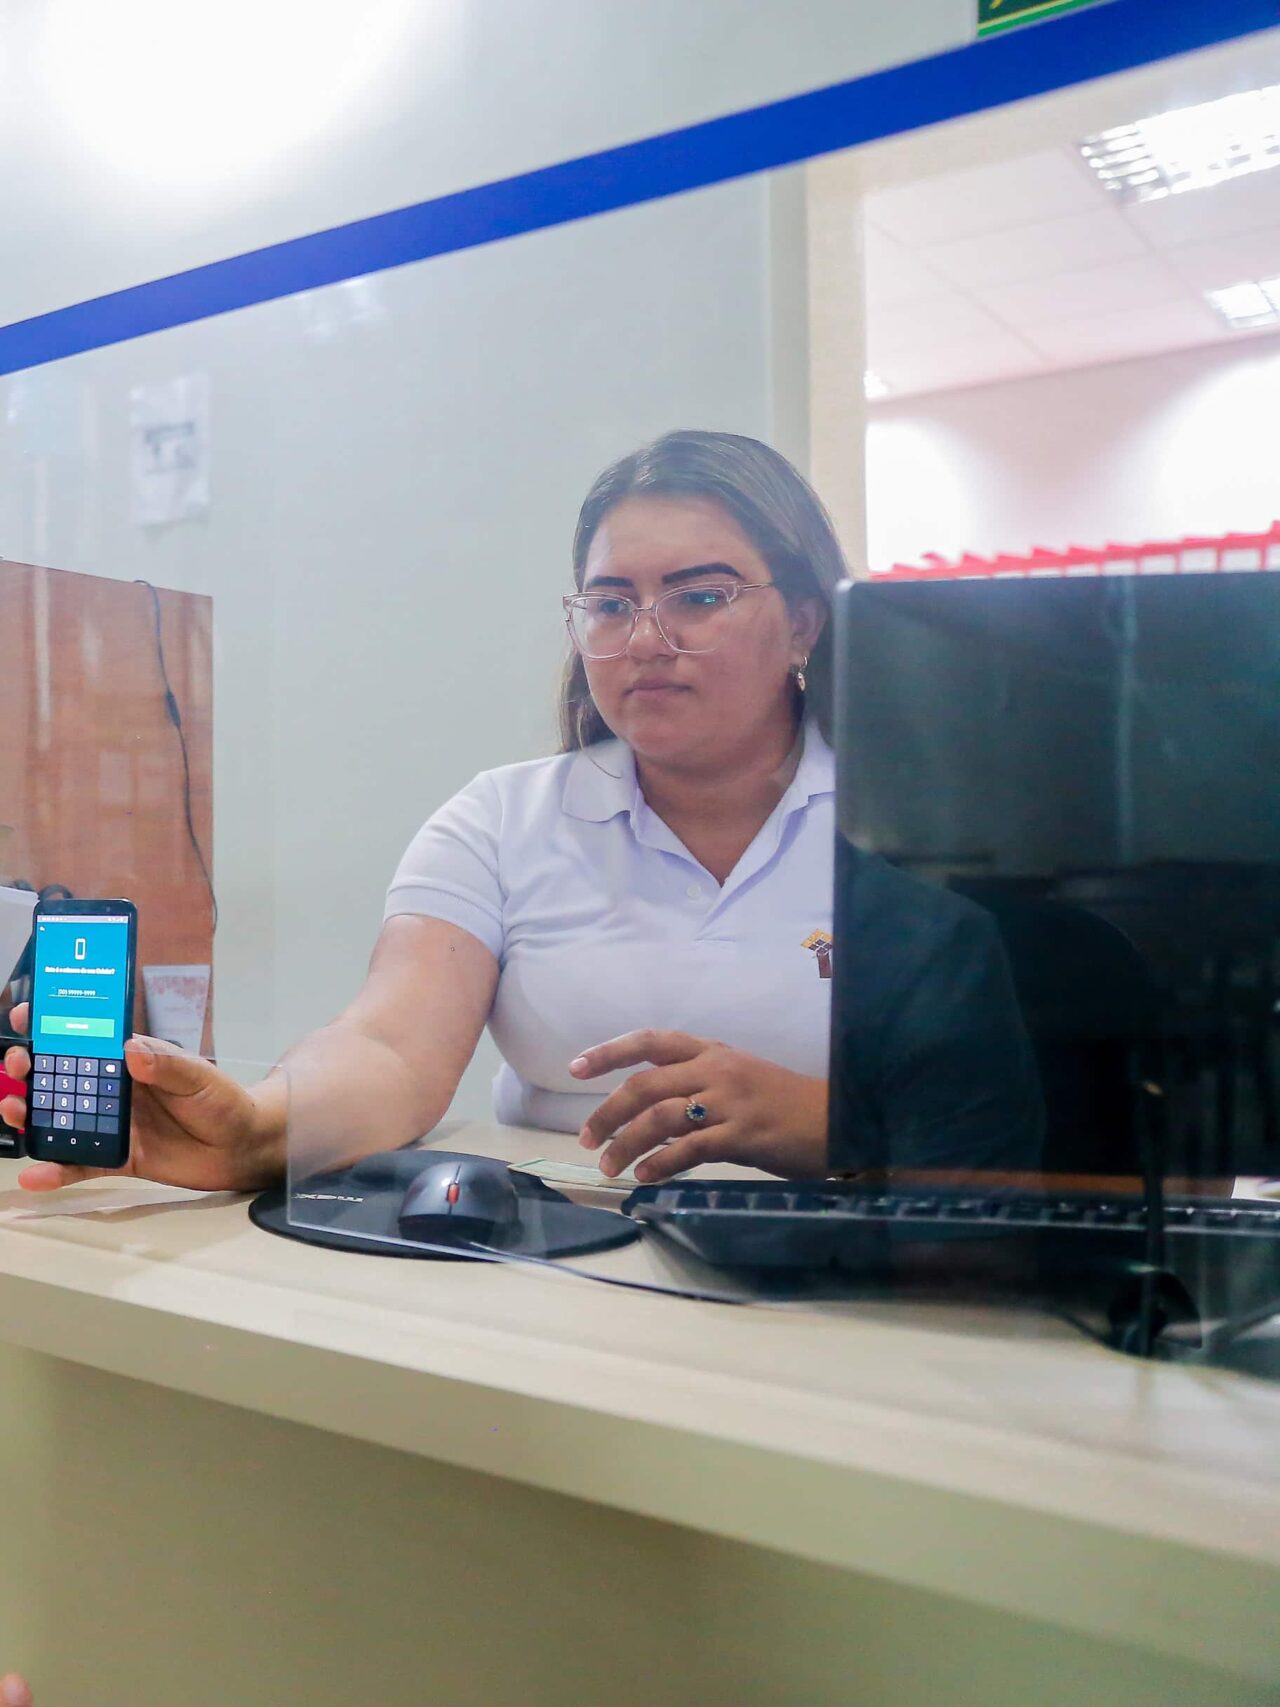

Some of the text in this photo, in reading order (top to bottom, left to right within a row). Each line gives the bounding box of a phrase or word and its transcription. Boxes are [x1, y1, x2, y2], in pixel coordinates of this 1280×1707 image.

[42, 1059, 91, 1071] 1 2 3
[40, 1077, 90, 1090] 4 5 6
[40, 1095, 90, 1109] 7 8 9
[60, 1115, 66, 1125] 0
